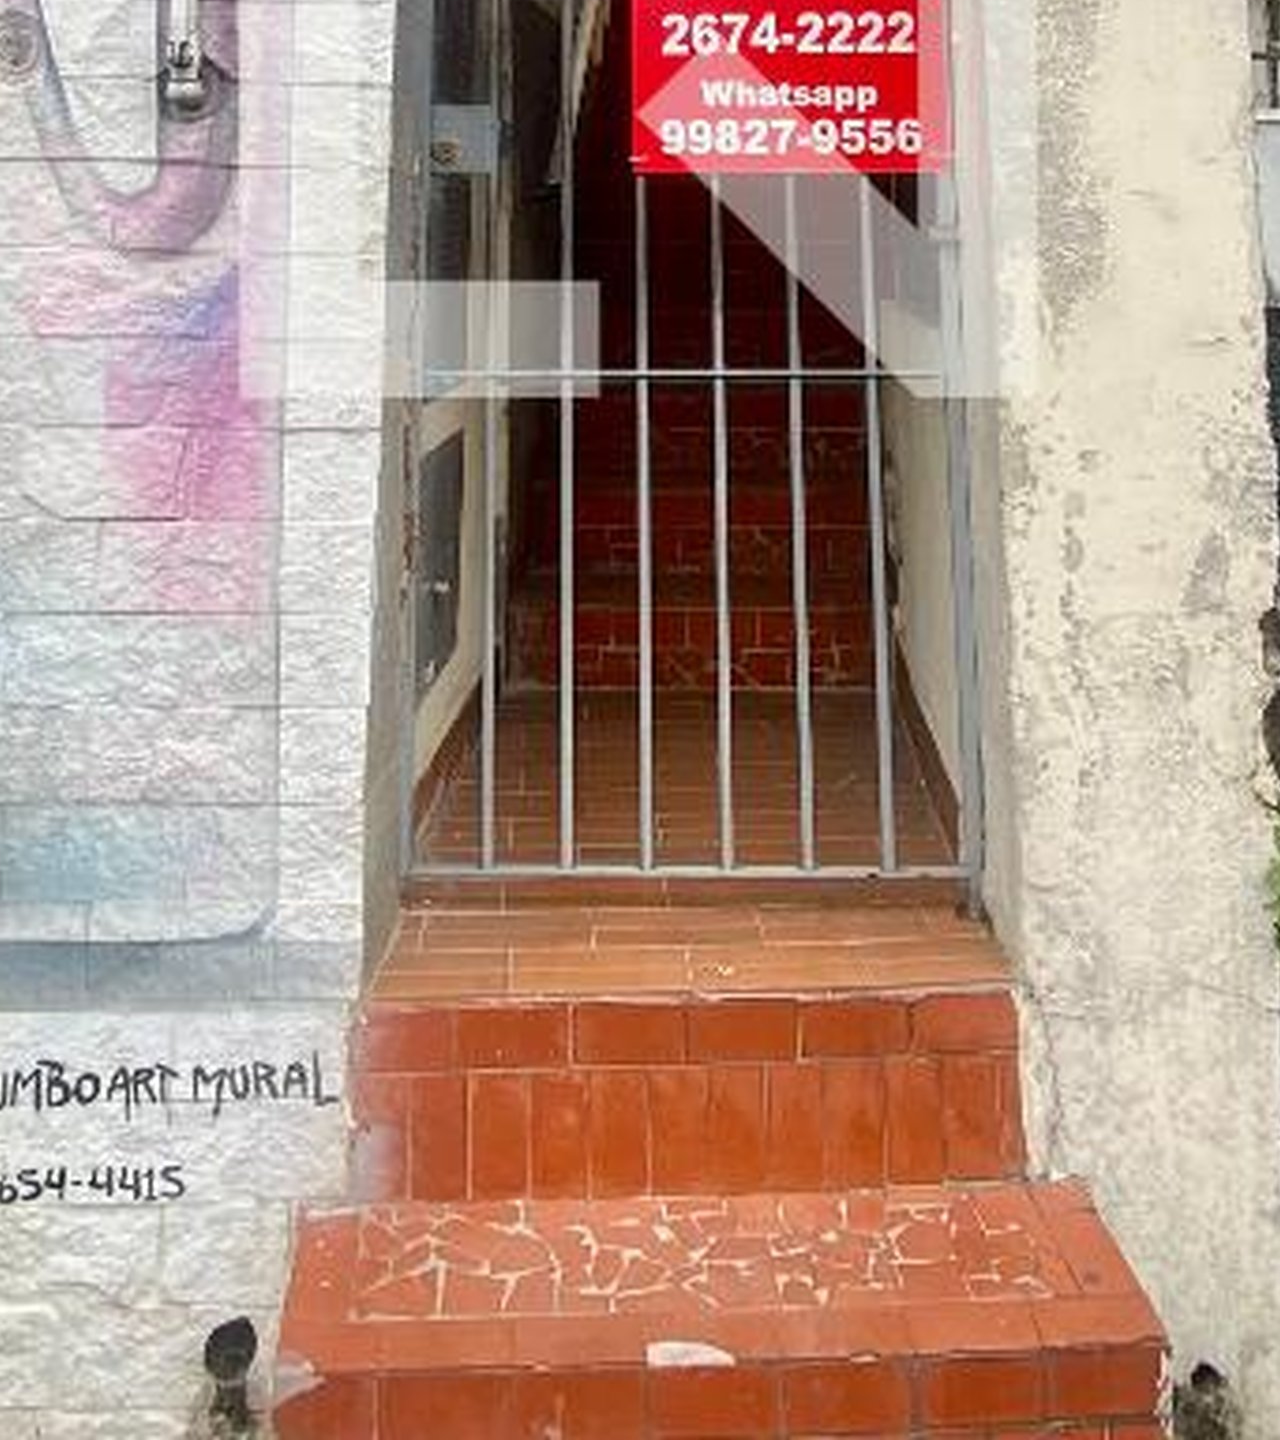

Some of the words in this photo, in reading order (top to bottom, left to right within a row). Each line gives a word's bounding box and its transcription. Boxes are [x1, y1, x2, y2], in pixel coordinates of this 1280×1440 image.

[661, 11, 915, 56] 2674-2222
[700, 80, 878, 112] Whatsapp
[660, 118, 922, 156] 99827-9556
[192, 1050, 340, 1116] MURAL
